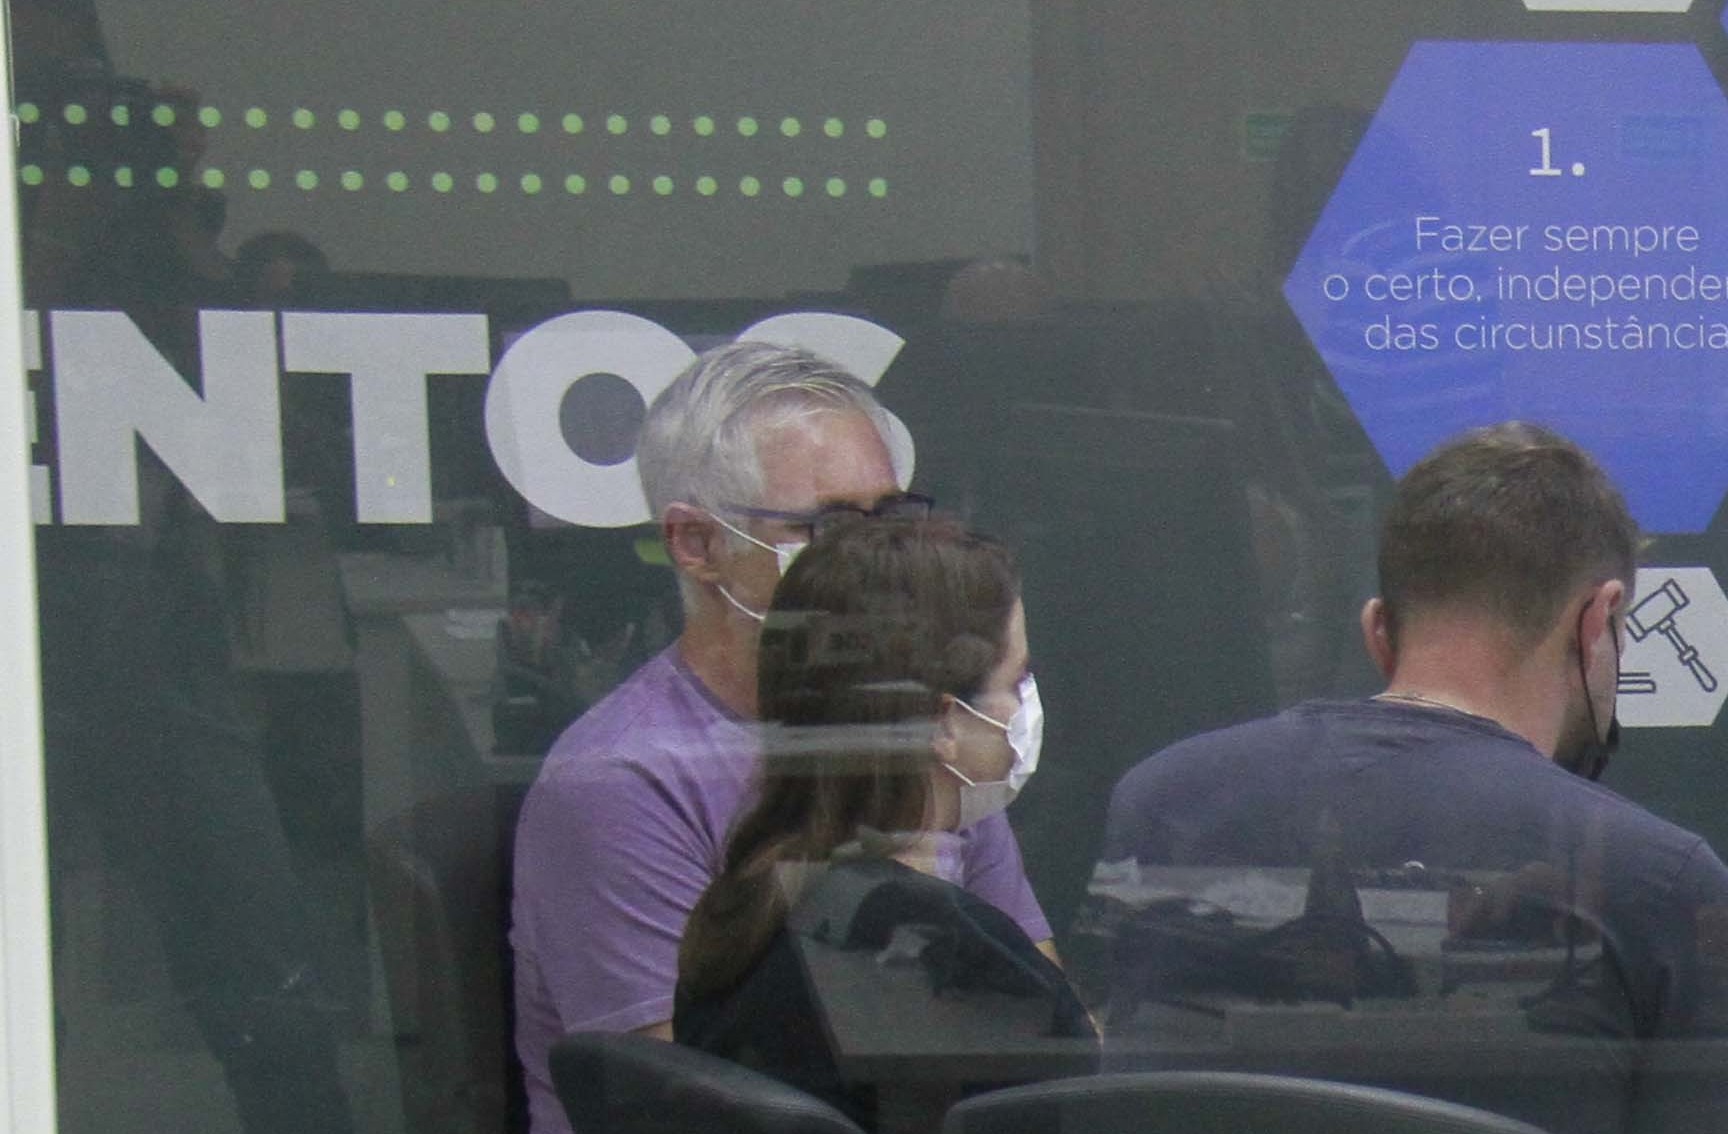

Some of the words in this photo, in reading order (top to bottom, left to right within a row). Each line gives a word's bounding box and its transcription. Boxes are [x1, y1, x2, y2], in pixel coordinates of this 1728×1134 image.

[1529, 127, 1586, 177] 1.
[1415, 215, 1529, 252] Fazer
[1544, 225, 1699, 256] sempre
[1323, 274, 1349, 301] o
[1364, 269, 1482, 302] certo,
[1364, 315, 1439, 350] das
